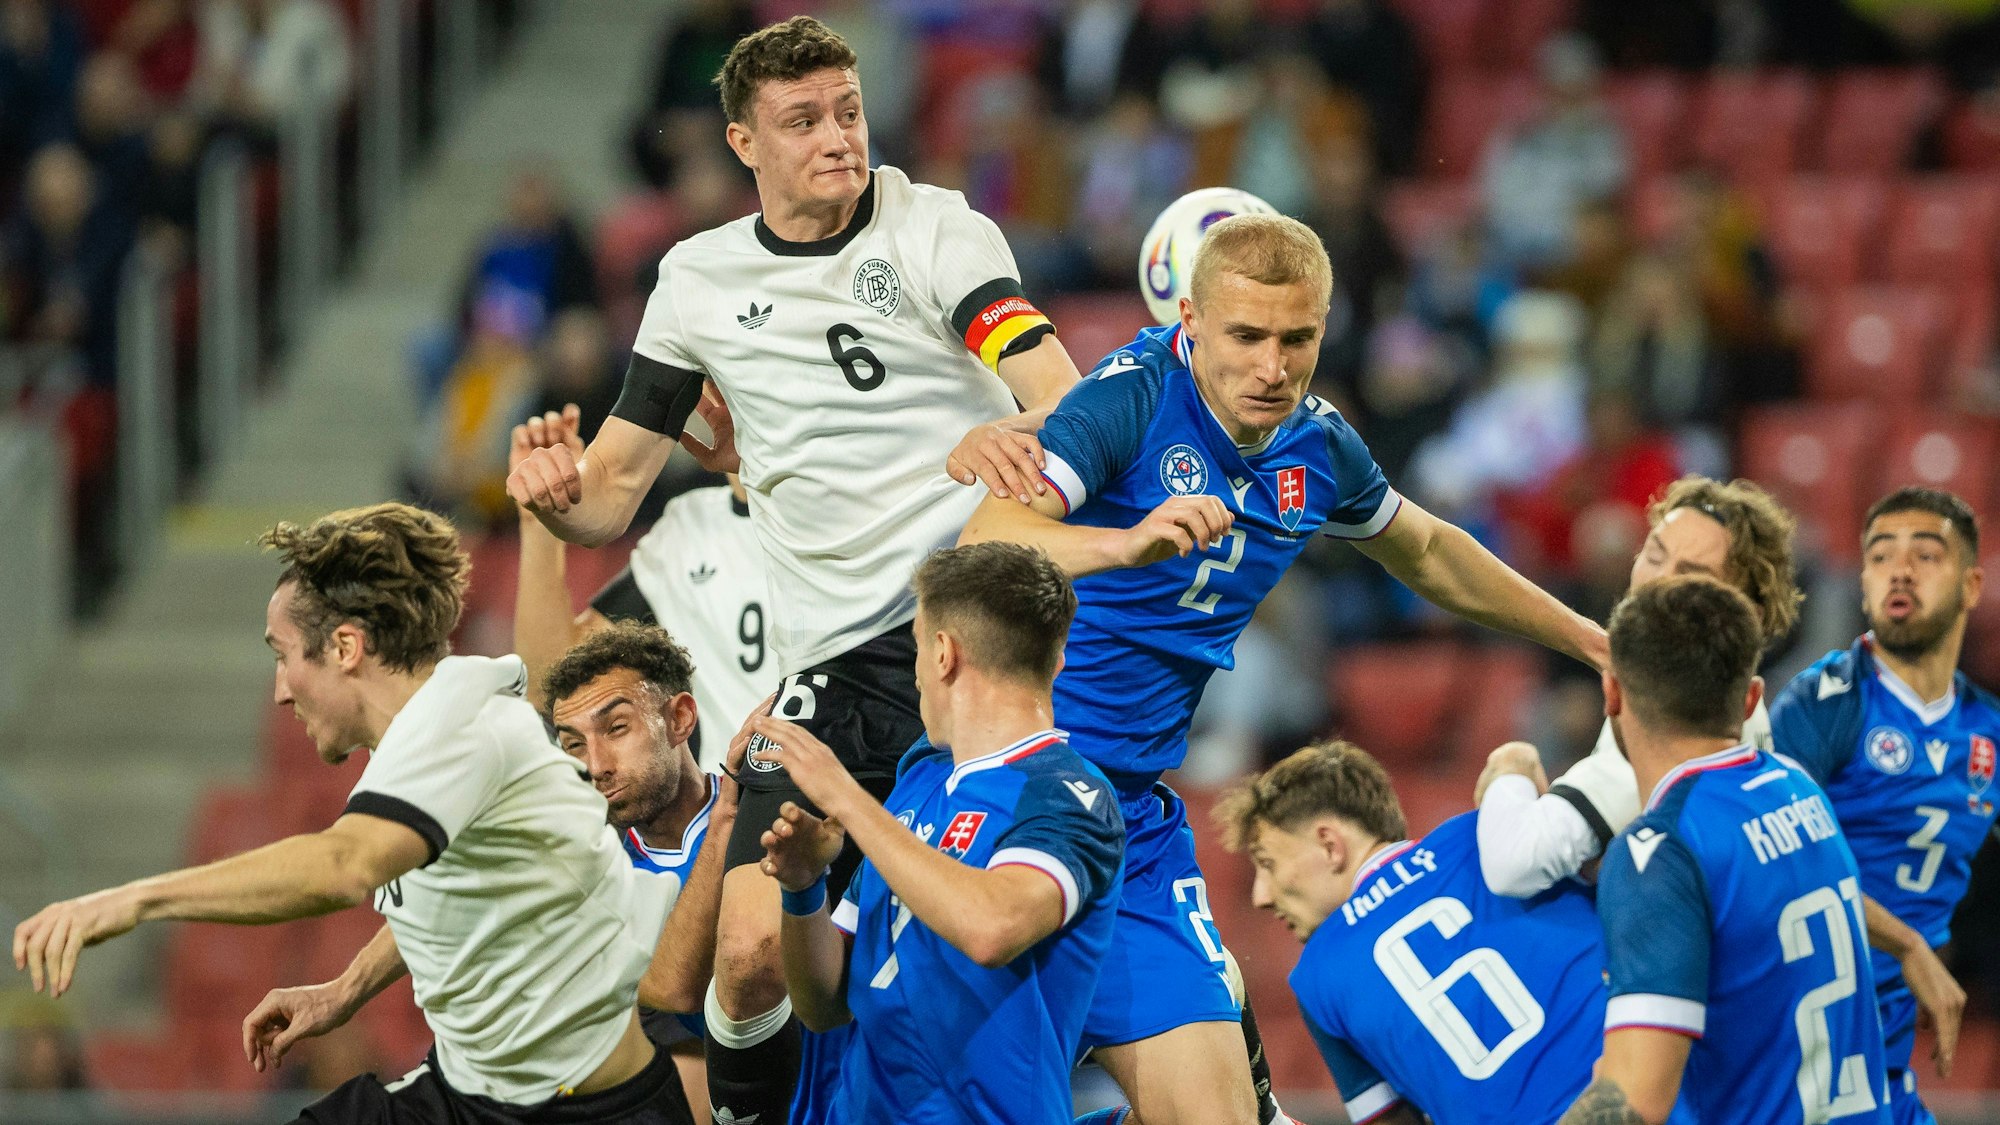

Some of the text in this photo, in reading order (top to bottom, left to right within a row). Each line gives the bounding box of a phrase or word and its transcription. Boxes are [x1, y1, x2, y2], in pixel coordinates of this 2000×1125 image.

[825, 322, 886, 392] 6
[1177, 528, 1247, 615] 2
[738, 601, 765, 673] 9
[771, 673, 829, 720] 6
[1895, 805, 1950, 893] 3
[1172, 876, 1226, 963] 2
[1372, 895, 1546, 1081] 6
